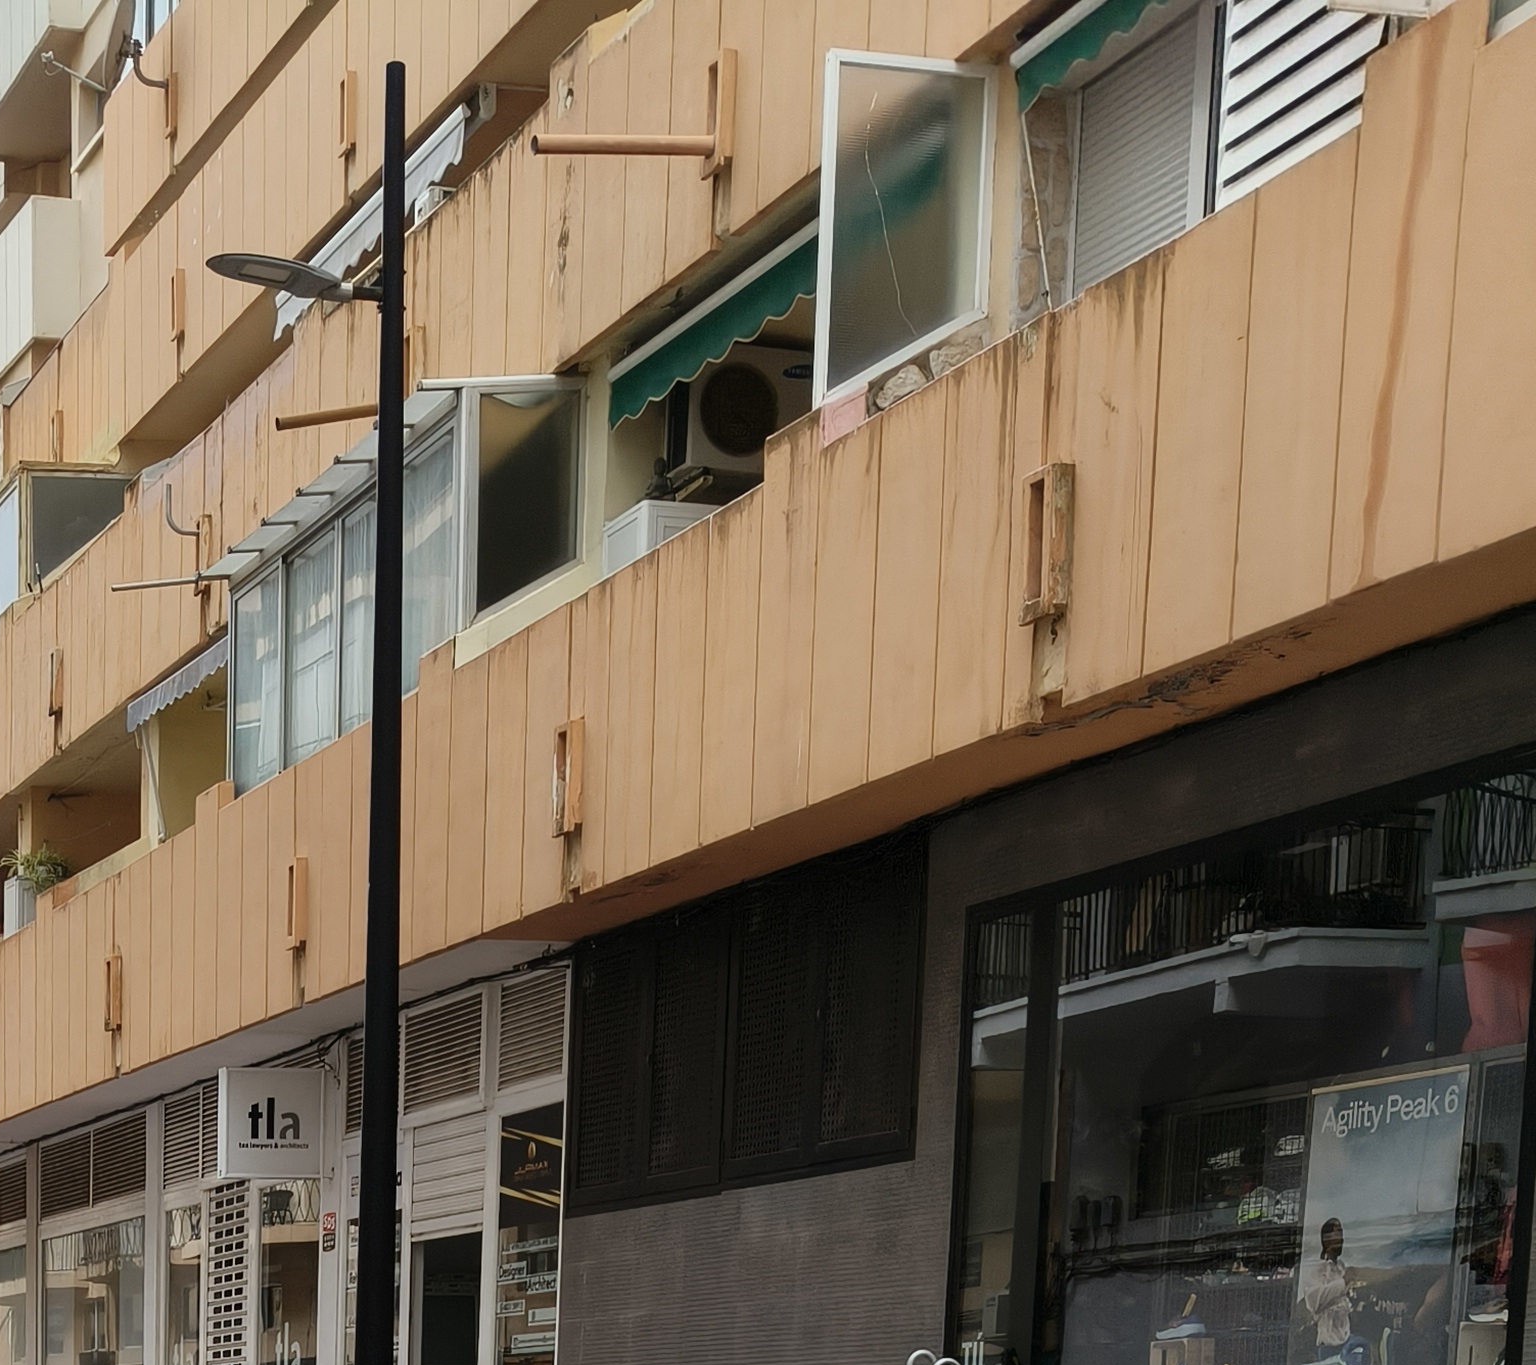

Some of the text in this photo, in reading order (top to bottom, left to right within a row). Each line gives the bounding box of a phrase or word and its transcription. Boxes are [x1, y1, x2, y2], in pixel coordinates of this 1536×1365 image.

[248, 1097, 300, 1140] tla
[1321, 1085, 1459, 1138] Agility Peak 6
[499, 1264, 526, 1280] Designer
